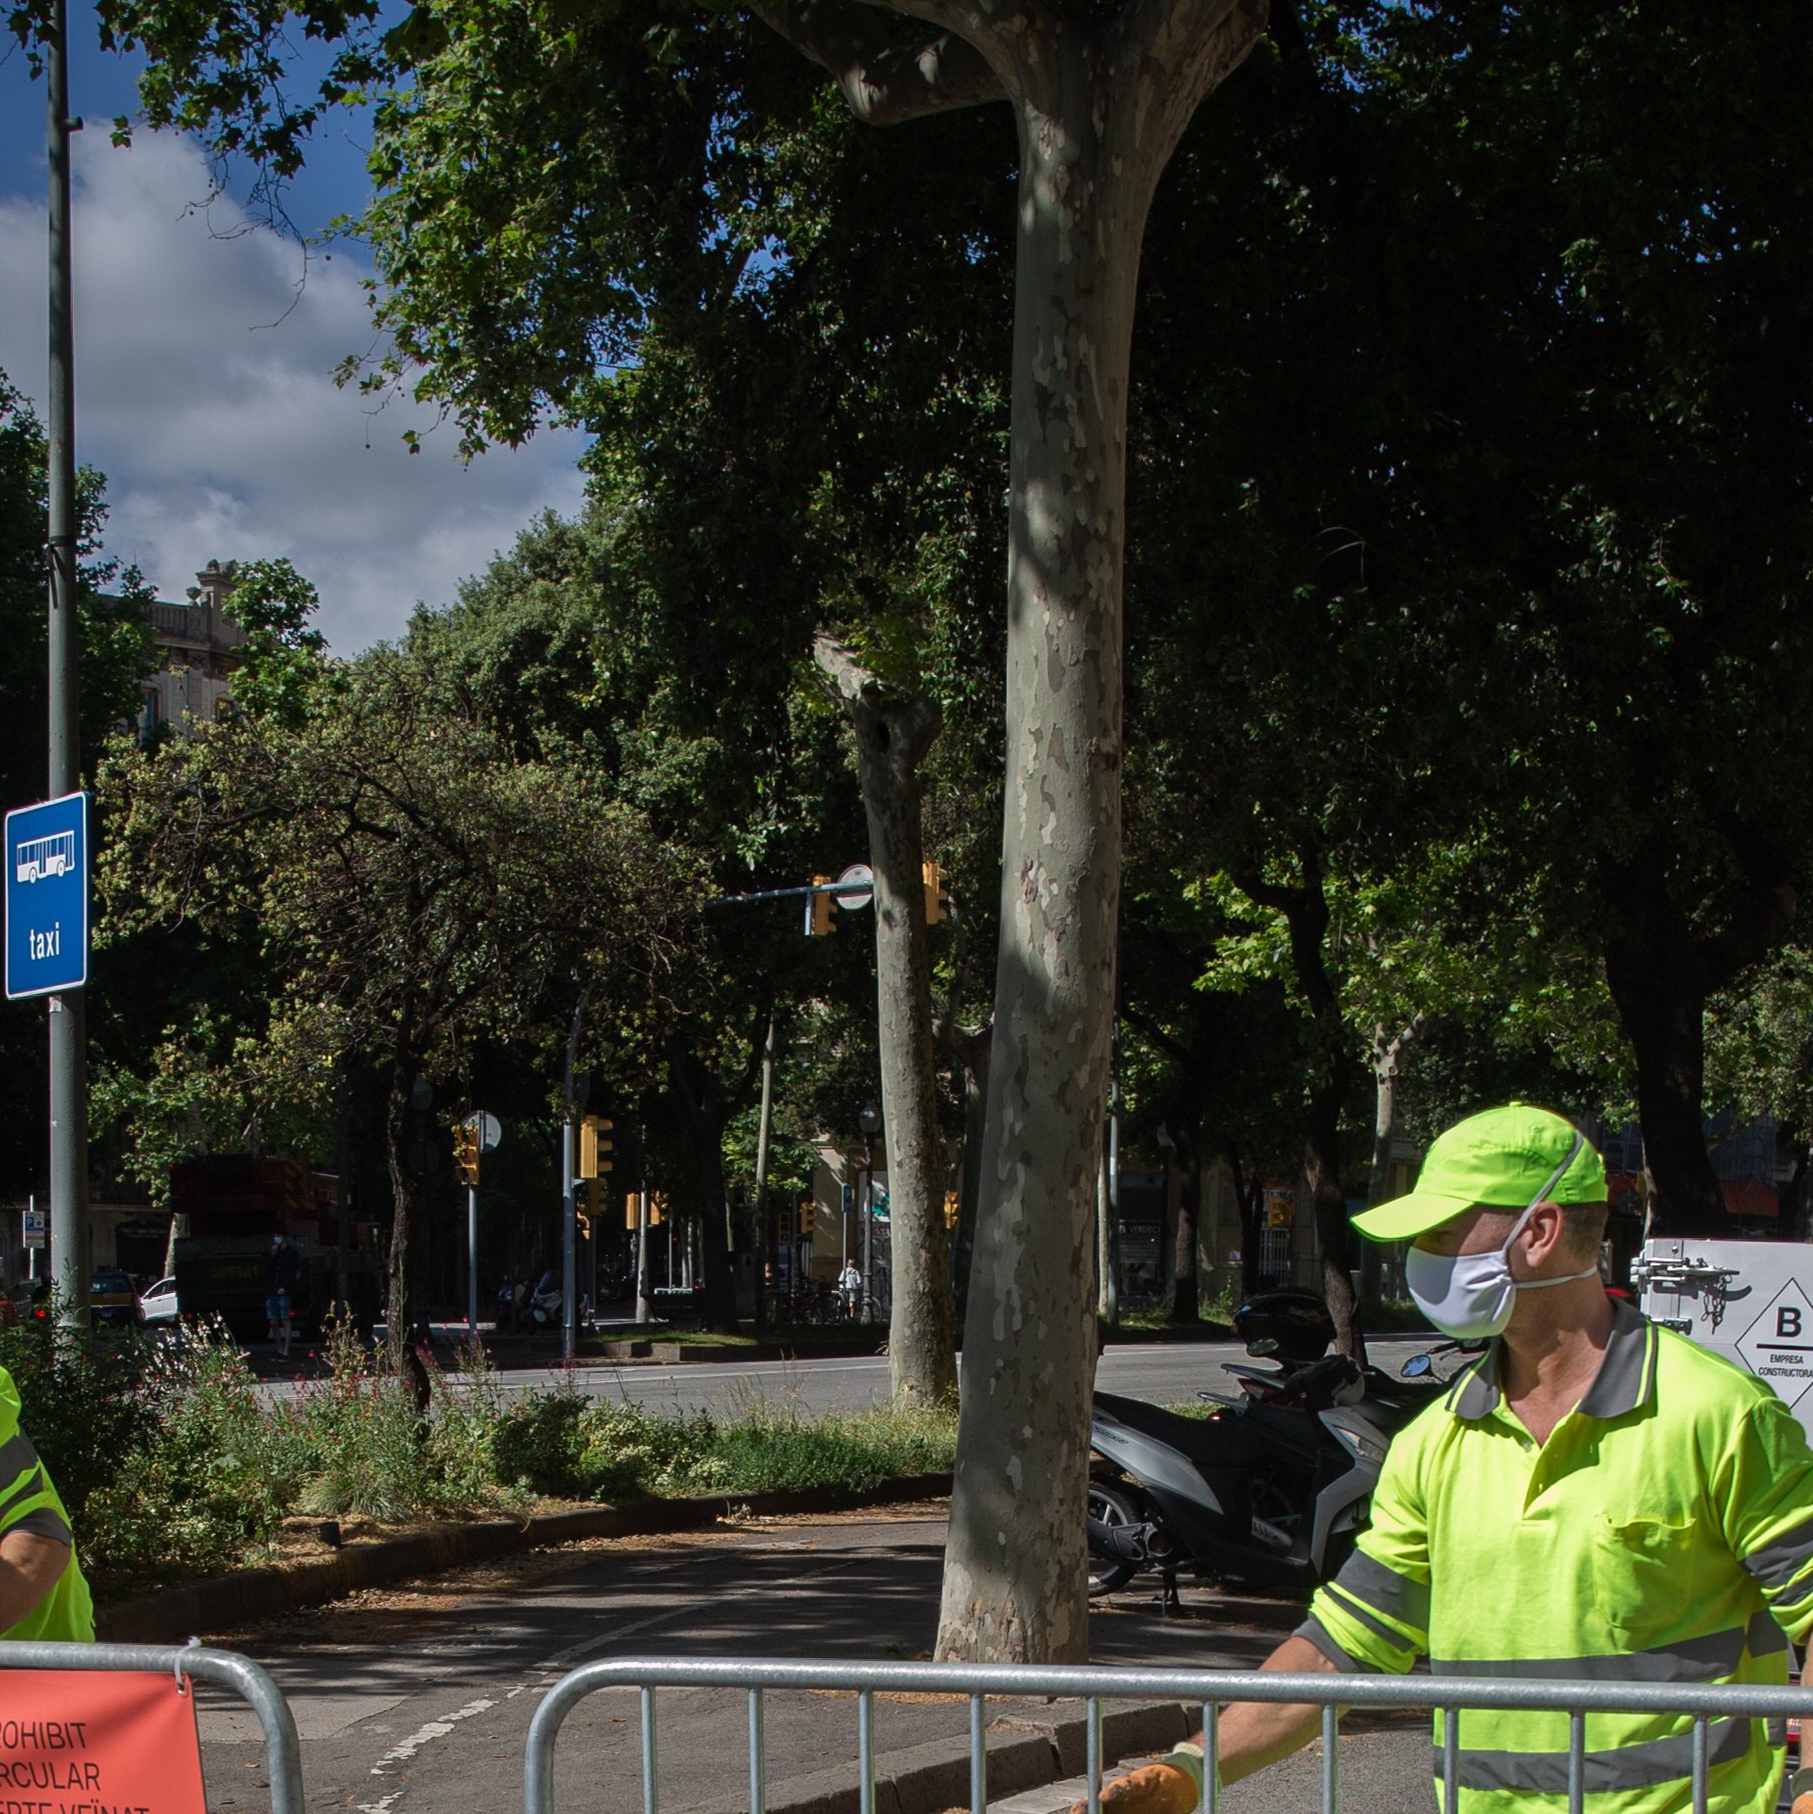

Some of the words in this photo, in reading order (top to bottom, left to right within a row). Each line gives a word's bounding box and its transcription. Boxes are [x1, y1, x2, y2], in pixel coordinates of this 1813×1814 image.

[29, 921, 60, 960] taxi
[1776, 1307, 1802, 1338] B
[1770, 1354, 1804, 1365] EMPRESA
[1758, 1366, 1813, 1379] CONSTRUCTORA
